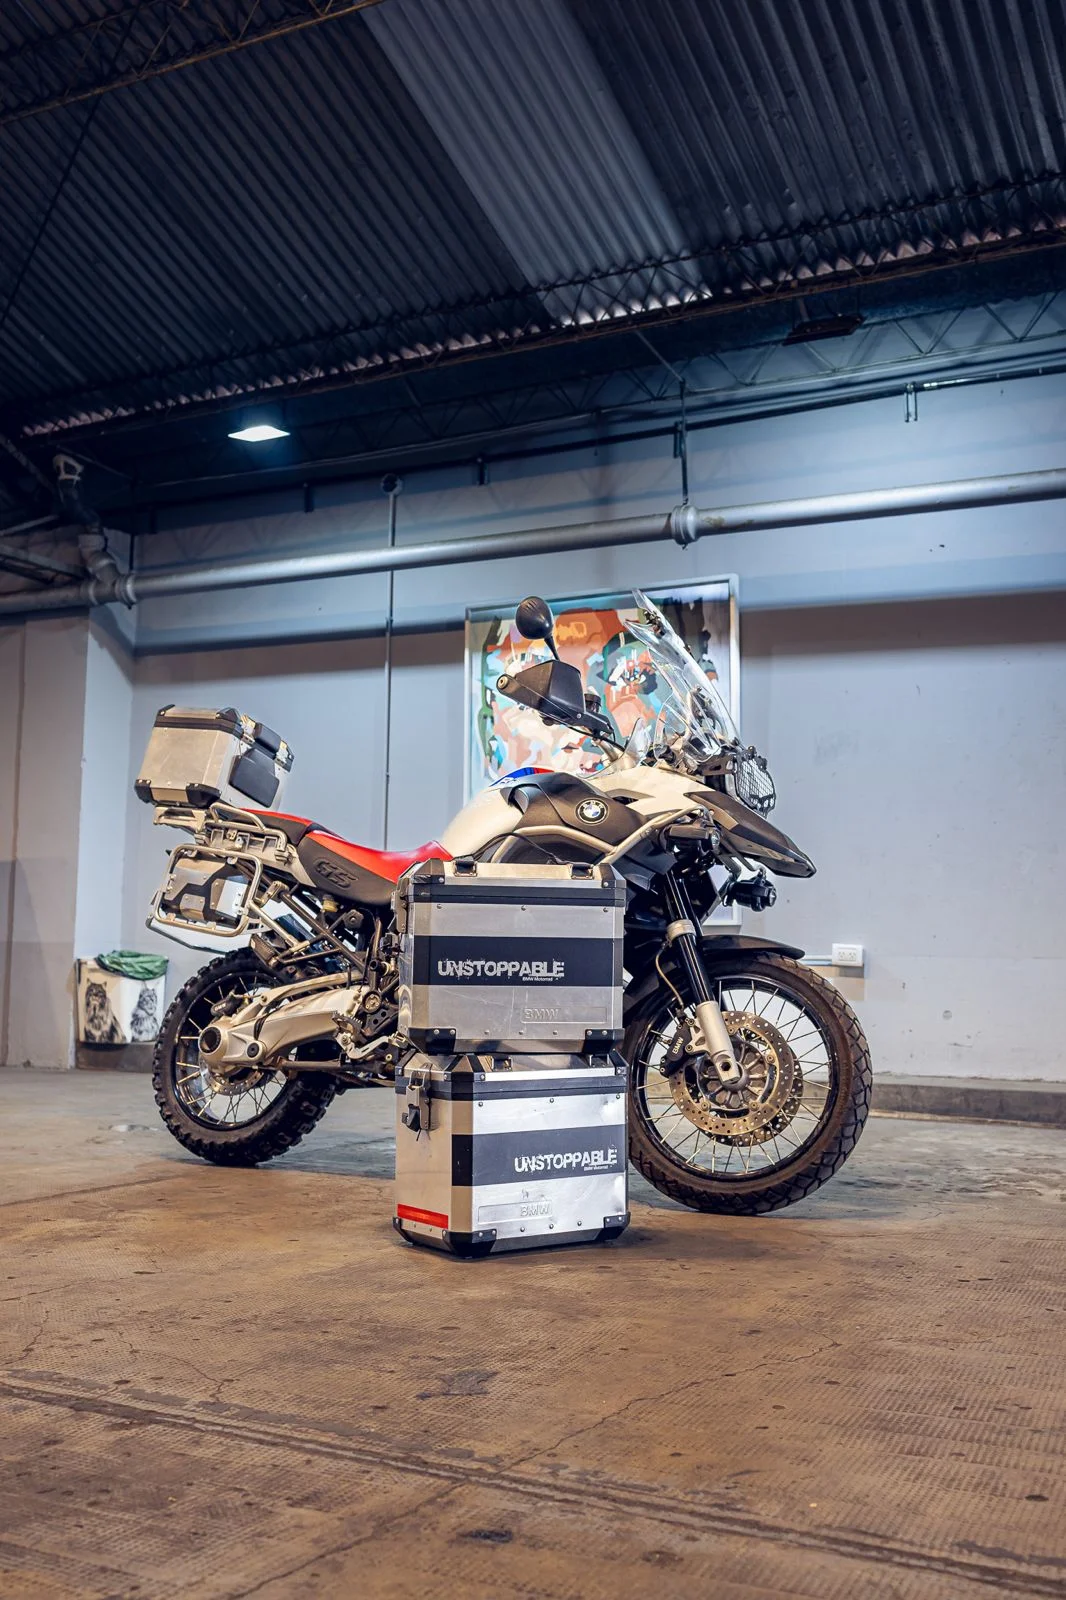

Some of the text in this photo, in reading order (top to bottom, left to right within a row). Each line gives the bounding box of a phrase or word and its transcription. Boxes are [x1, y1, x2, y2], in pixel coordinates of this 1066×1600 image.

[437, 959, 565, 978] UNSTOPPABLE
[523, 1008, 560, 1020] BMW
[671, 1036, 684, 1055] BMW
[514, 1148, 618, 1173] UNSTOPPABLE
